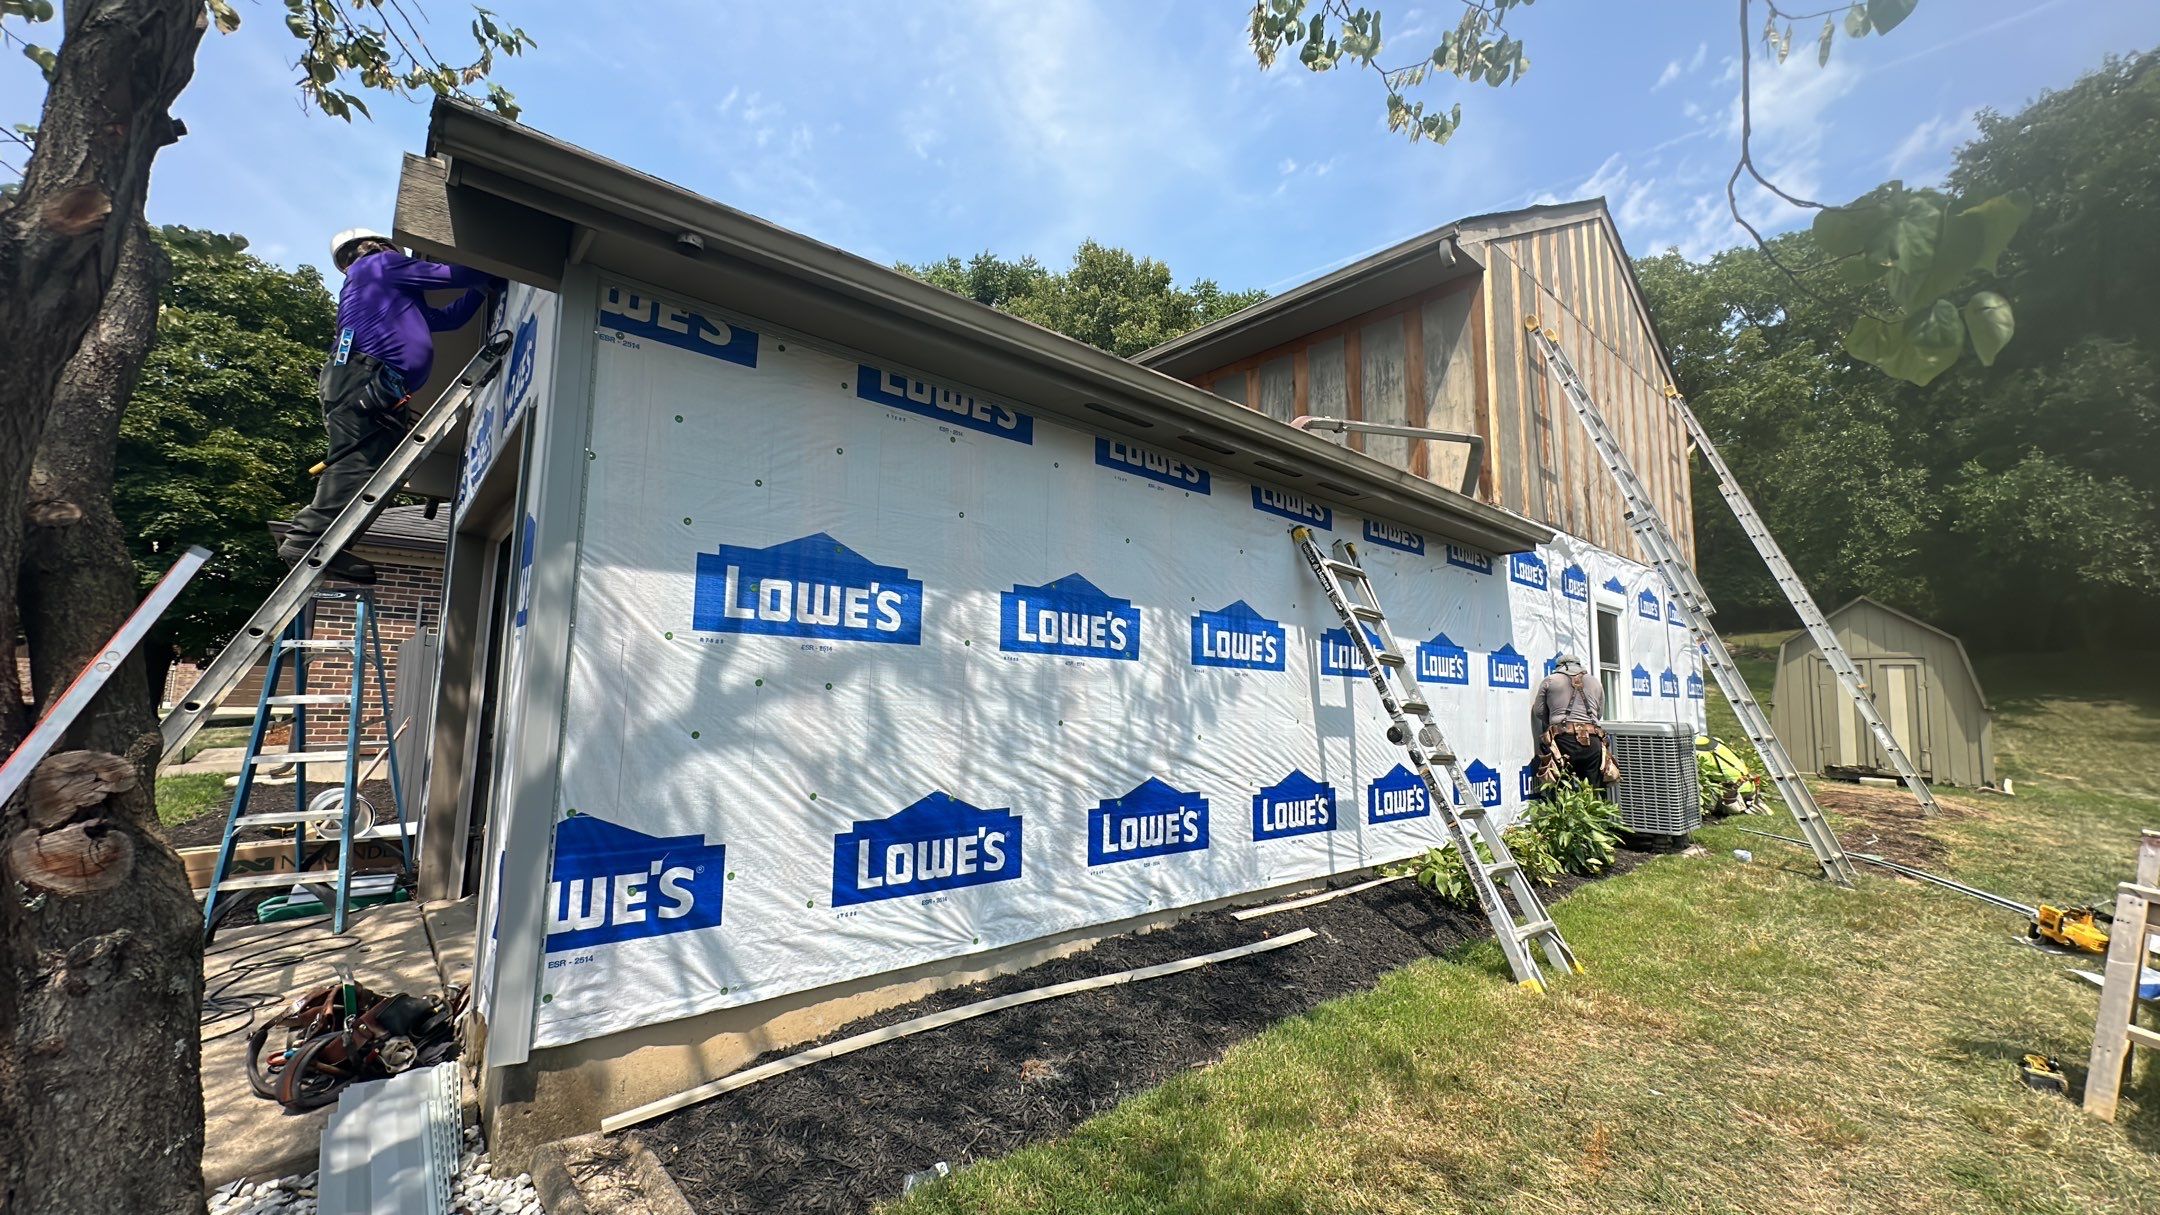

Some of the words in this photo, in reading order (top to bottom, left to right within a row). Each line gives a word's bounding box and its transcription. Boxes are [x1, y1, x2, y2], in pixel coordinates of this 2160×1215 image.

[724, 564, 902, 632] LOWE'S
[1018, 599, 1127, 651] LOWE'S
[1202, 622, 1277, 664] LOWE'S
[1421, 650, 1464, 679] LOWE'S
[1492, 659, 1525, 684] LOWE'S
[1262, 793, 1330, 832] LOWE'S
[1374, 784, 1425, 817] LOWE'S
[1102, 805, 1199, 854] LOWE'S
[857, 826, 1006, 890] LOWE'S
[548, 959, 566, 969] ESR
[574, 955, 594, 966] 2514
